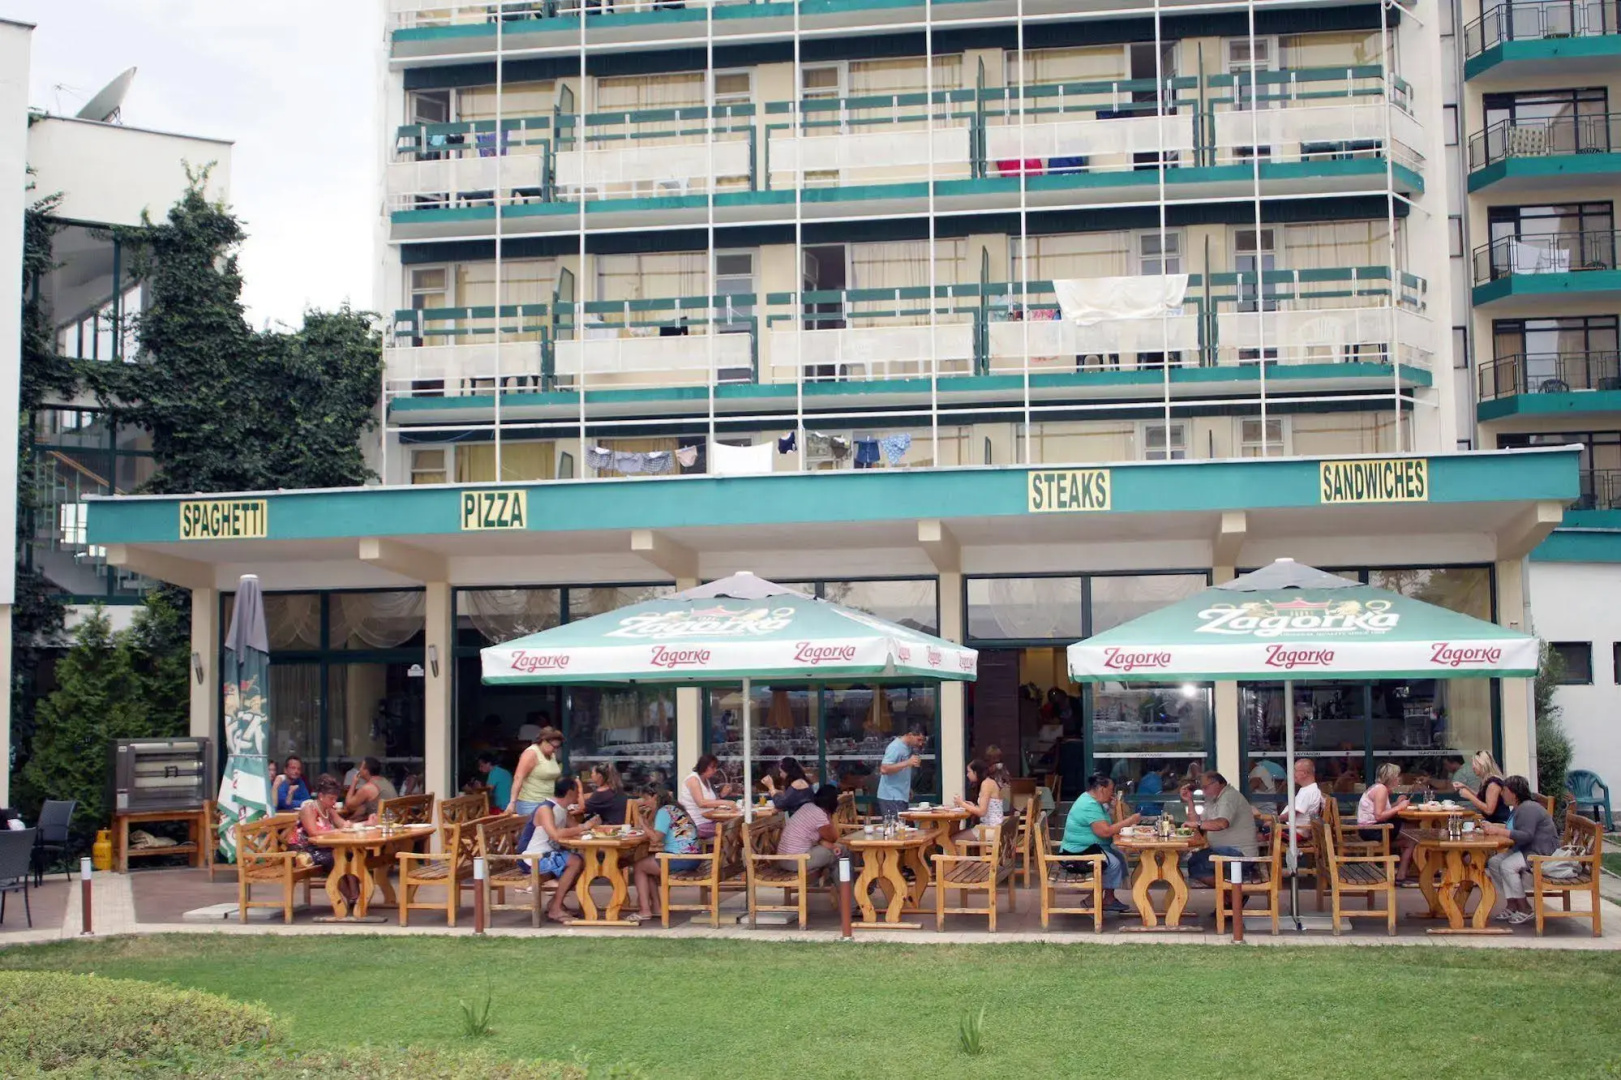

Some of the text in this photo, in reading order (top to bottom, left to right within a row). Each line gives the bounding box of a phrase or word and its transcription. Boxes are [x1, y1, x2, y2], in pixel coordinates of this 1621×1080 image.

[1032, 471, 1106, 509] STEAKS
[1323, 460, 1424, 501] SANDWICHES
[183, 502, 264, 537] SPAGHETTI
[464, 492, 524, 528] PIZZA
[1193, 608, 1400, 637] Zagorka
[511, 650, 570, 673] Zagorka
[650, 646, 711, 669] Zagorka
[794, 642, 856, 665] Zagorka
[1104, 647, 1172, 672] Zagorka
[1264, 644, 1335, 669] Zagorka
[1430, 643, 1502, 667] Zagorka
